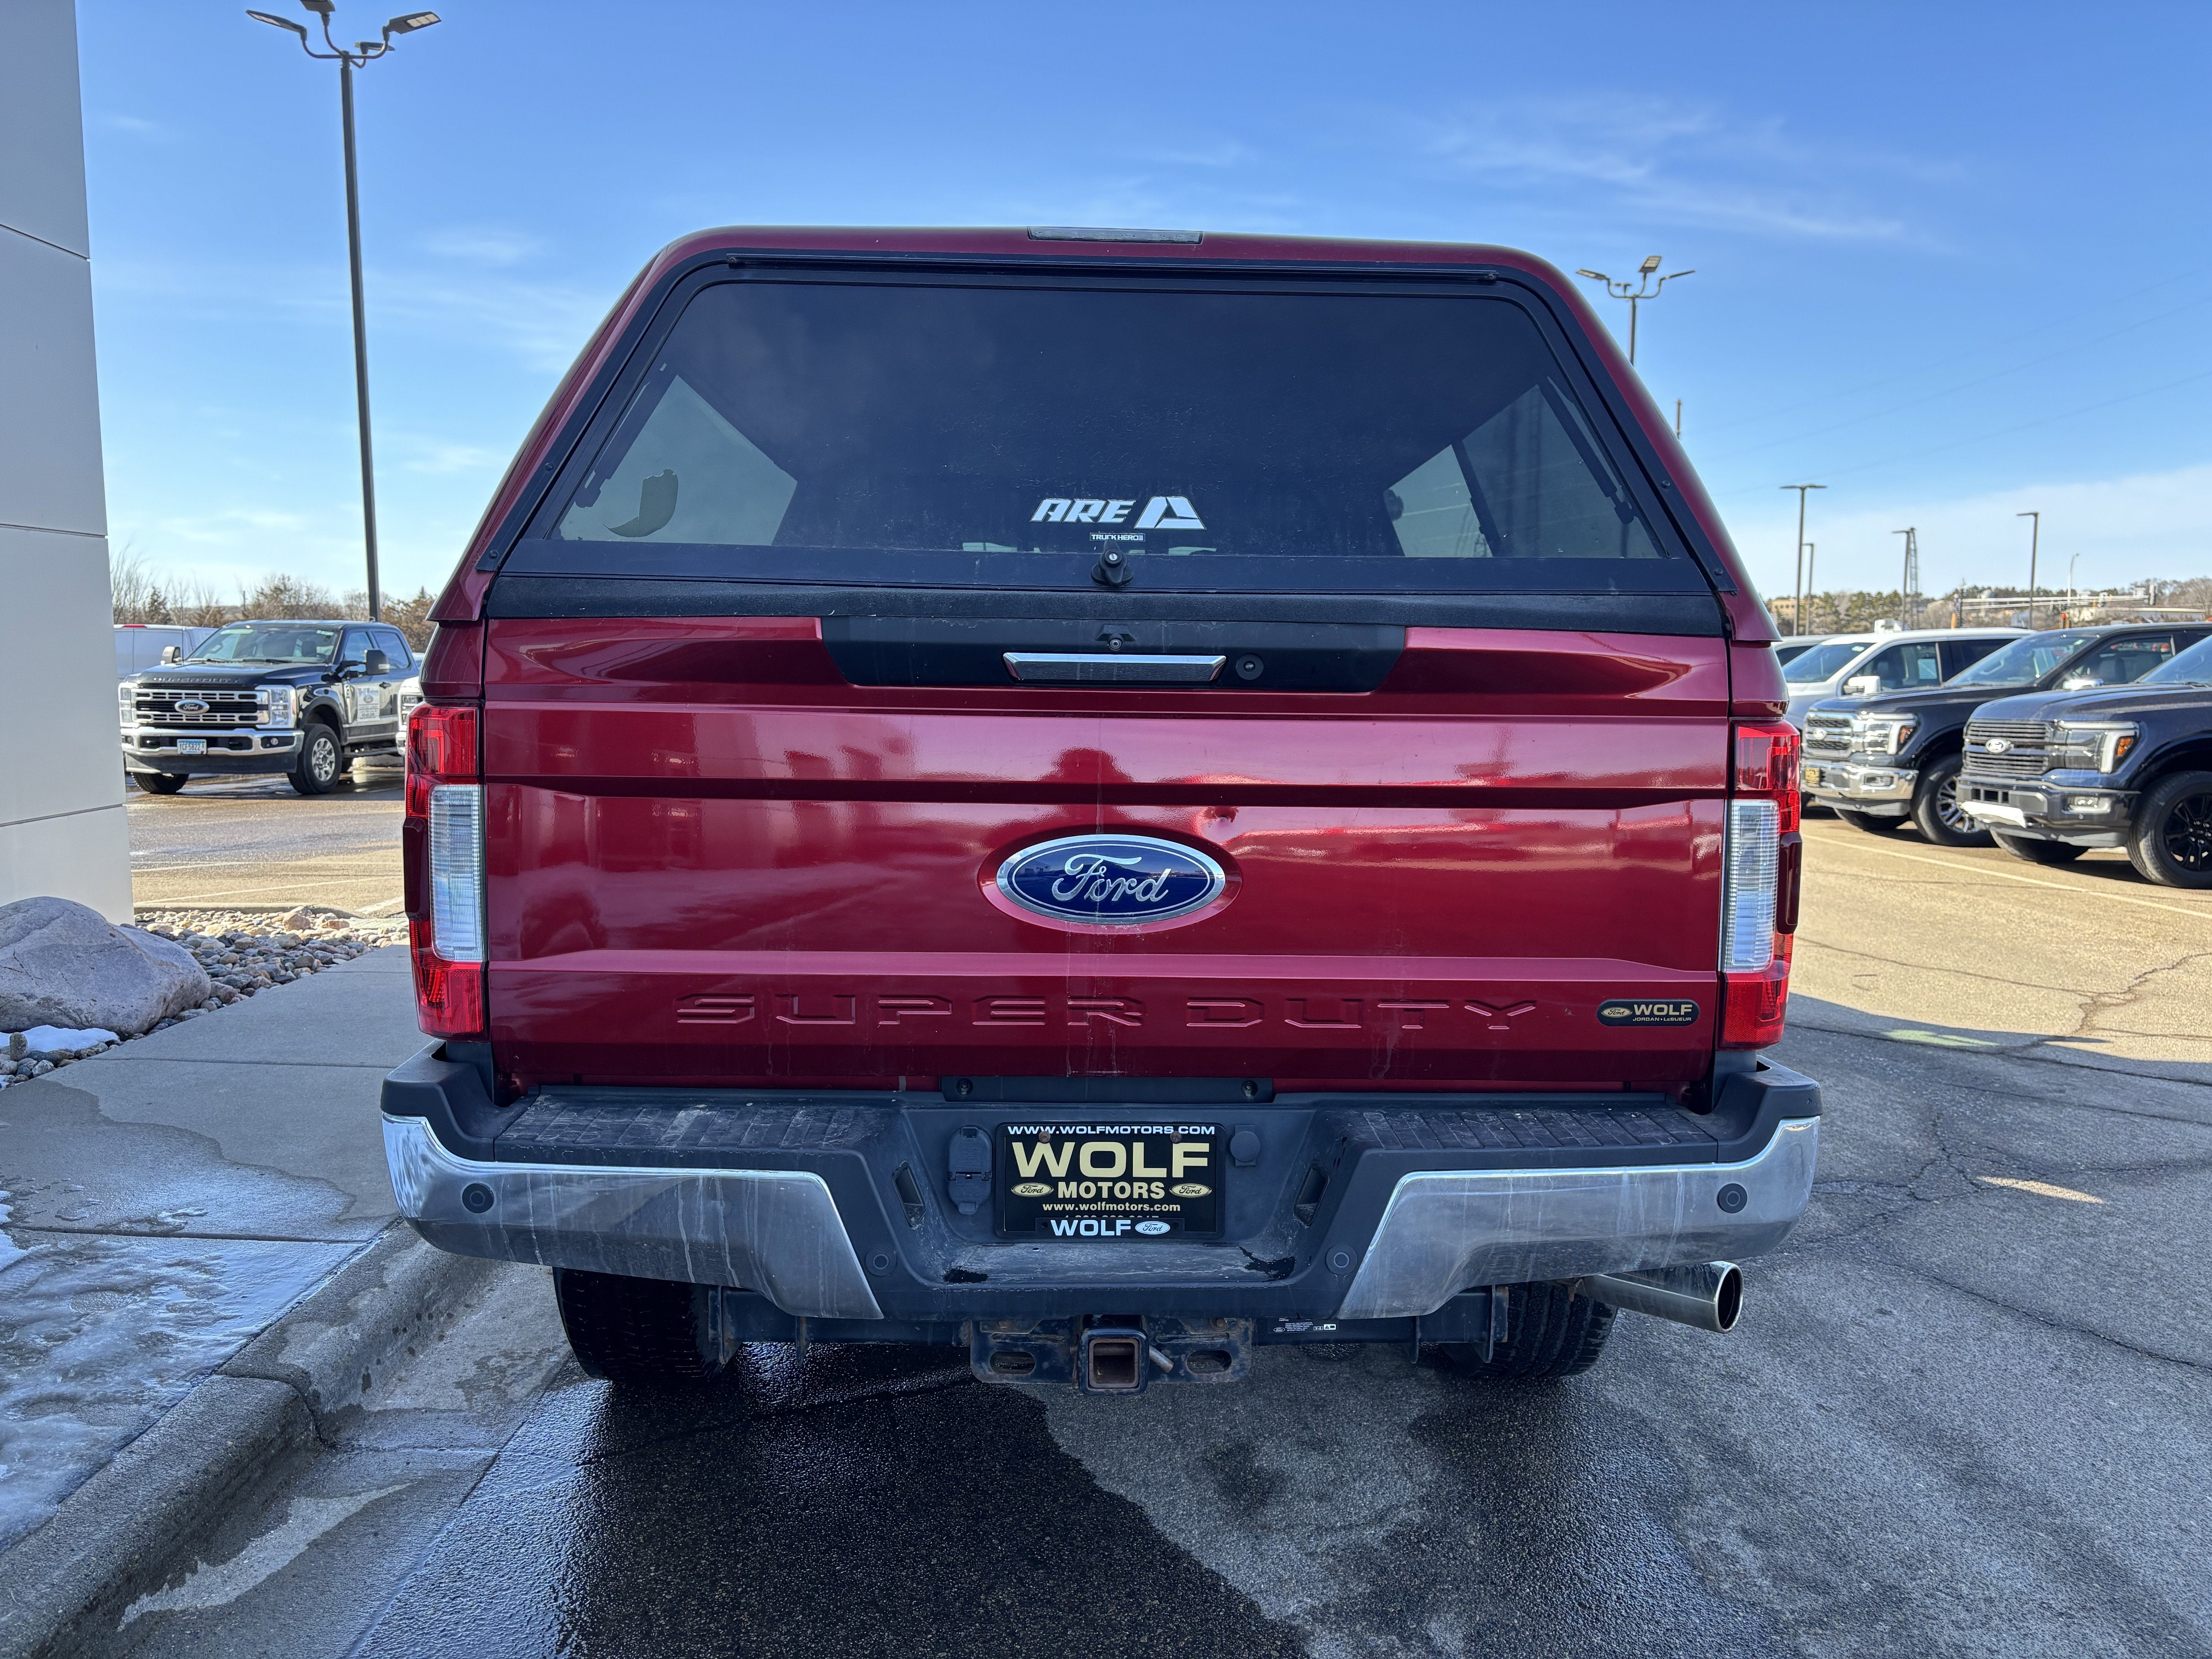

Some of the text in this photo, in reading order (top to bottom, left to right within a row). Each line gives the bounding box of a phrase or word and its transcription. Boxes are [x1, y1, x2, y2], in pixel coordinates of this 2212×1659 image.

[1030, 498, 1136, 523] ARE
[1051, 854, 1172, 902] Ford
[674, 994, 1537, 1029] SUPER DUTY
[1634, 1005, 1692, 1015] WOLF
[1008, 1126, 1215, 1135] WWW.WOLFMOTORSCOM
[1012, 1142, 1210, 1178] WOLF
[1021, 1185, 1043, 1194] Ford
[1058, 1181, 1165, 1199] MOTORS
[1179, 1185, 1202, 1195] Ford
[1042, 1202, 1180, 1211] www.wolfmotors.com
[1050, 1220, 1131, 1236] WOLF
[1142, 1223, 1163, 1231] Ford
